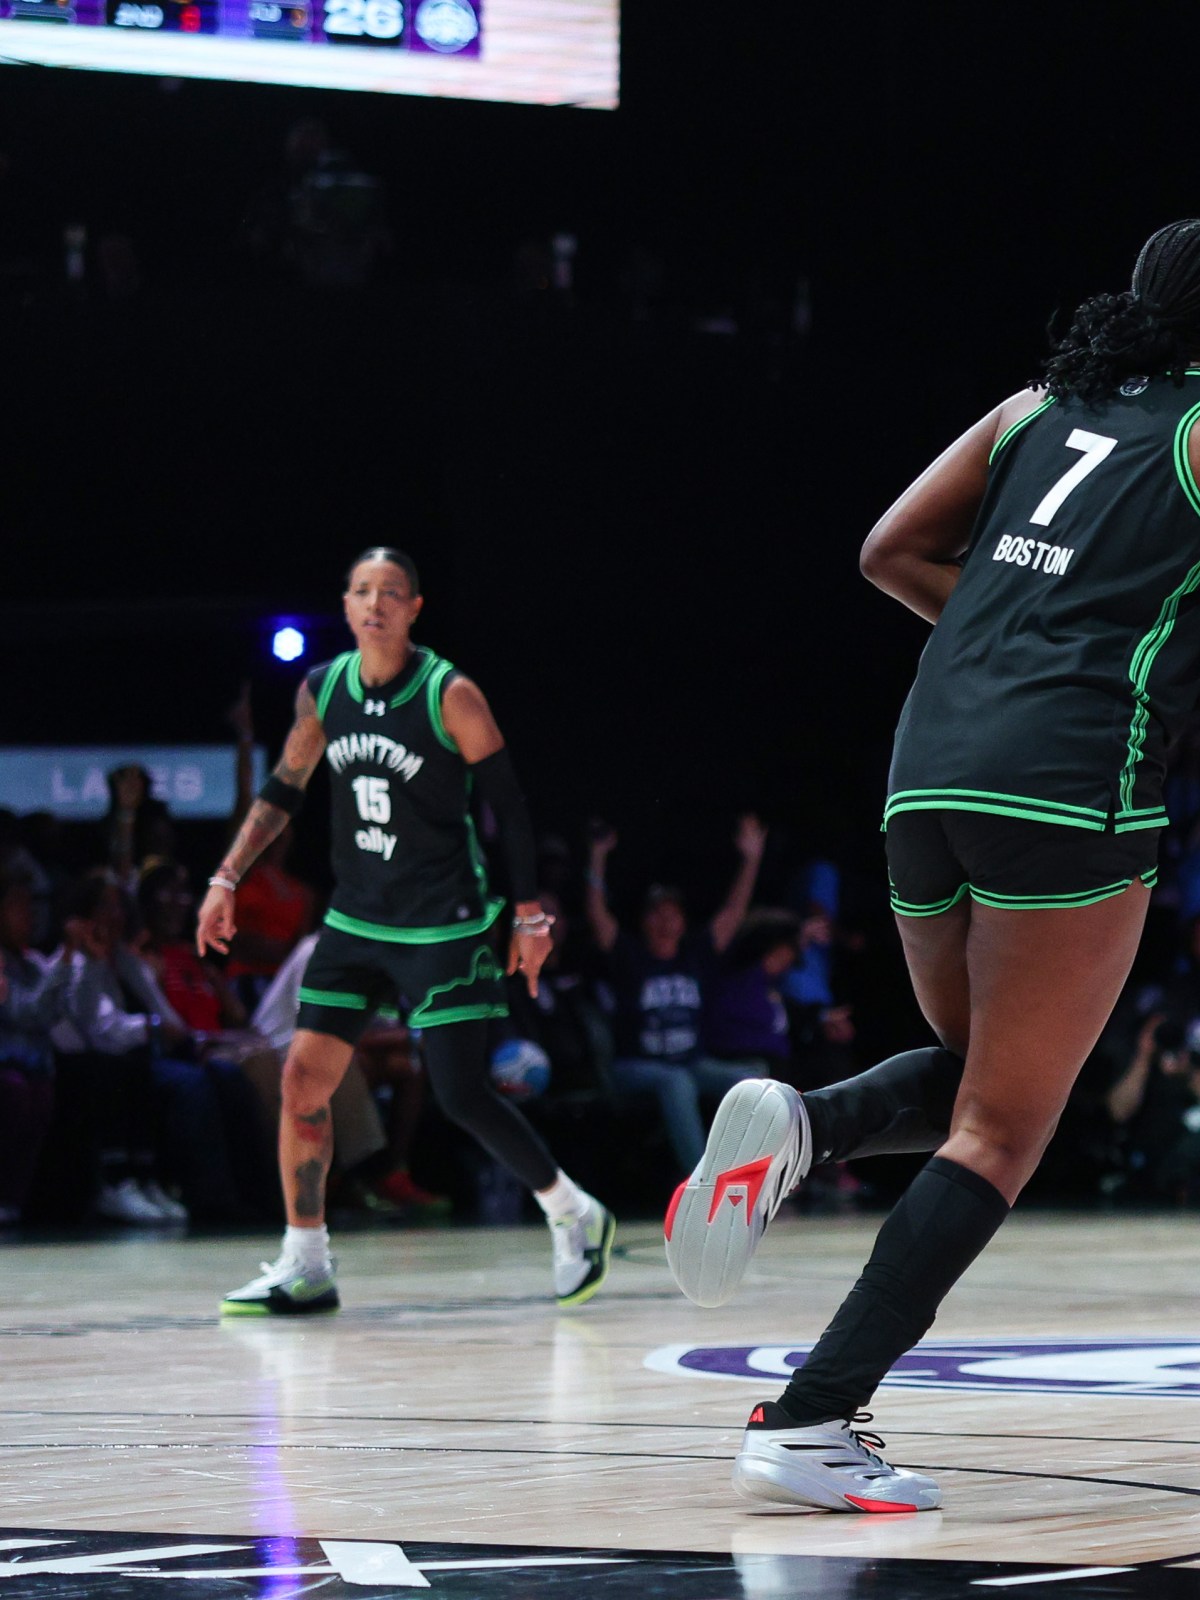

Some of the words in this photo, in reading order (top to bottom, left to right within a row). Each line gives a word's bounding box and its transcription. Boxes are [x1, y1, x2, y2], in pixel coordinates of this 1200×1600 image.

[1029, 428, 1119, 527] 7
[992, 534, 1075, 576] BOSTON
[327, 732, 424, 784] PHANTOM
[352, 775, 391, 825] 15
[355, 825, 397, 861] ally
